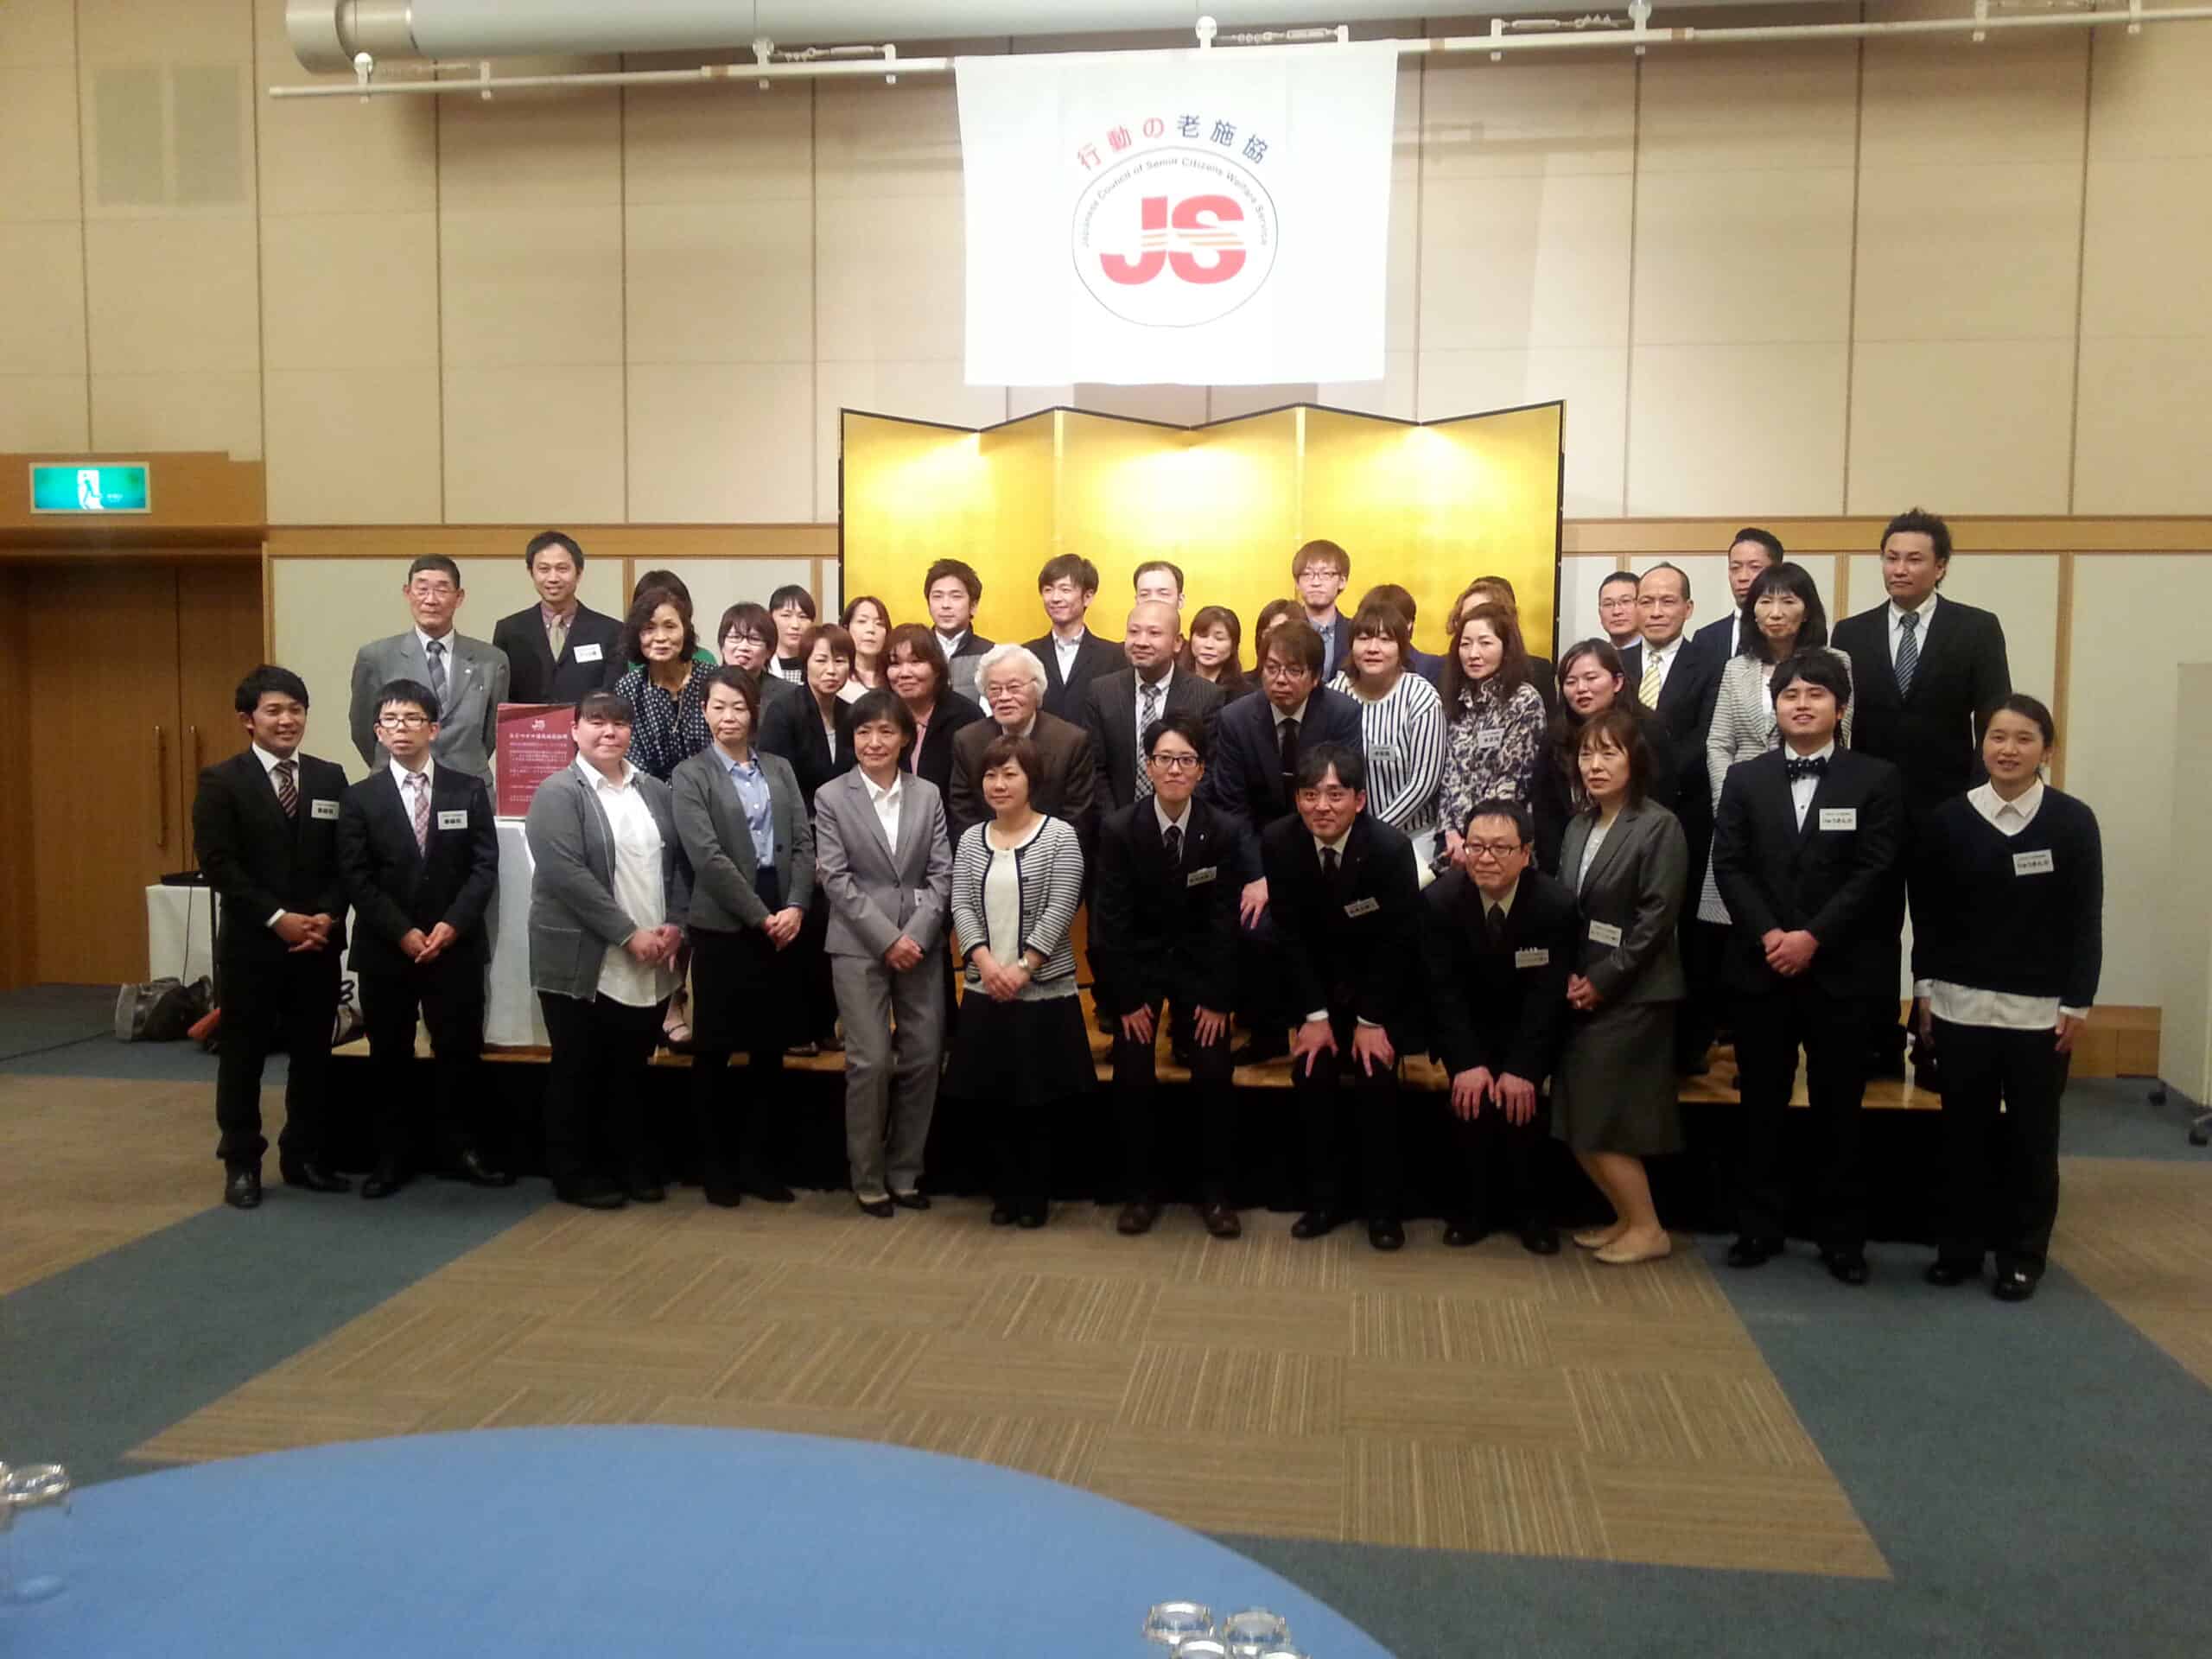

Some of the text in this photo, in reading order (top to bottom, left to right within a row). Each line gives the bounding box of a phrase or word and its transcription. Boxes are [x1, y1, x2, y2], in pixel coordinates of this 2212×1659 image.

[1077, 114, 1268, 170] 行動の老施協
[1099, 194, 1247, 285] JS
